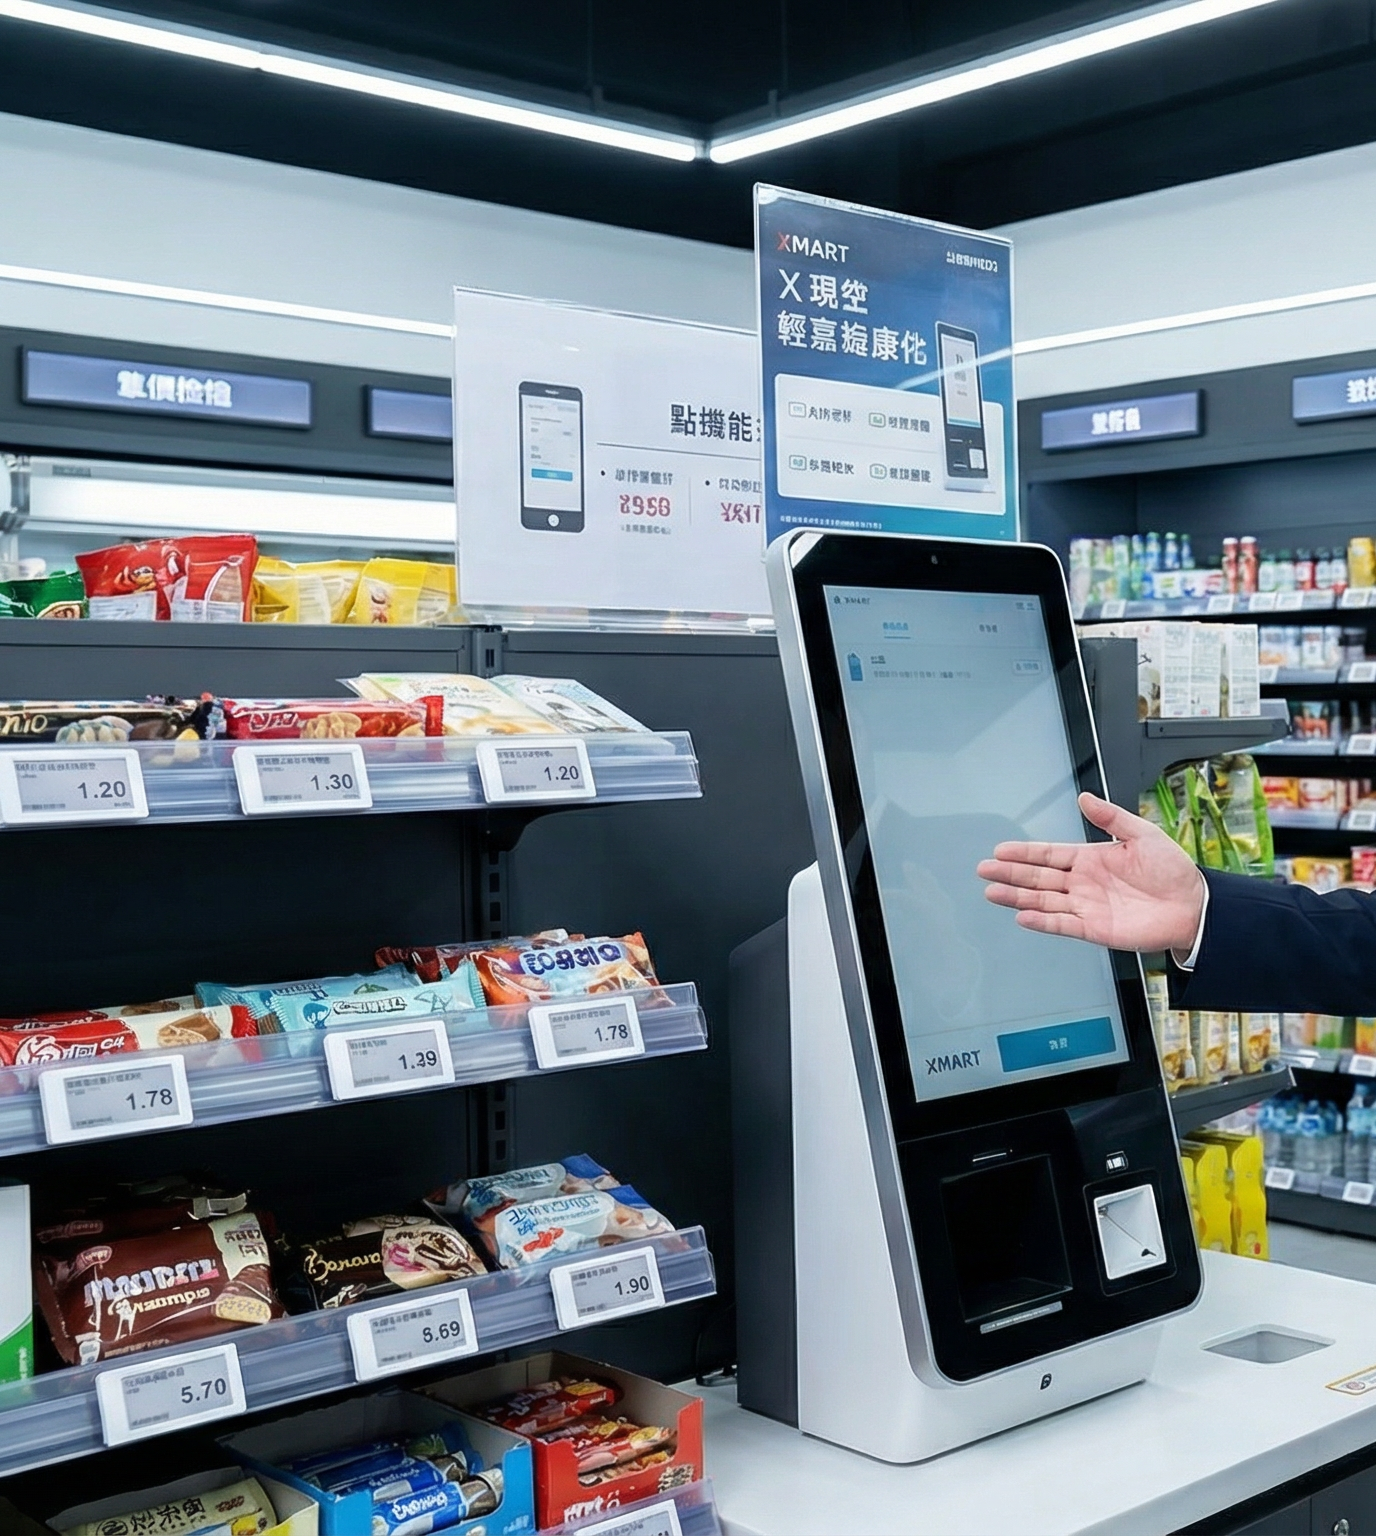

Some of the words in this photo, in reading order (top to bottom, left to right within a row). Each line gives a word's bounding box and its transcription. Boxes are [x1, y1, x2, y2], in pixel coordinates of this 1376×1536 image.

[776, 232, 850, 264] XMART
[310, 773, 353, 791] 1.30
[543, 765, 579, 781] 1.20
[77, 781, 126, 799] 1.20
[594, 1024, 629, 1042] 1.78
[925, 1050, 981, 1075] XMART
[126, 1088, 173, 1111] 1.78
[614, 1275, 650, 1296] 1.90
[181, 1378, 227, 1404] 5.70
